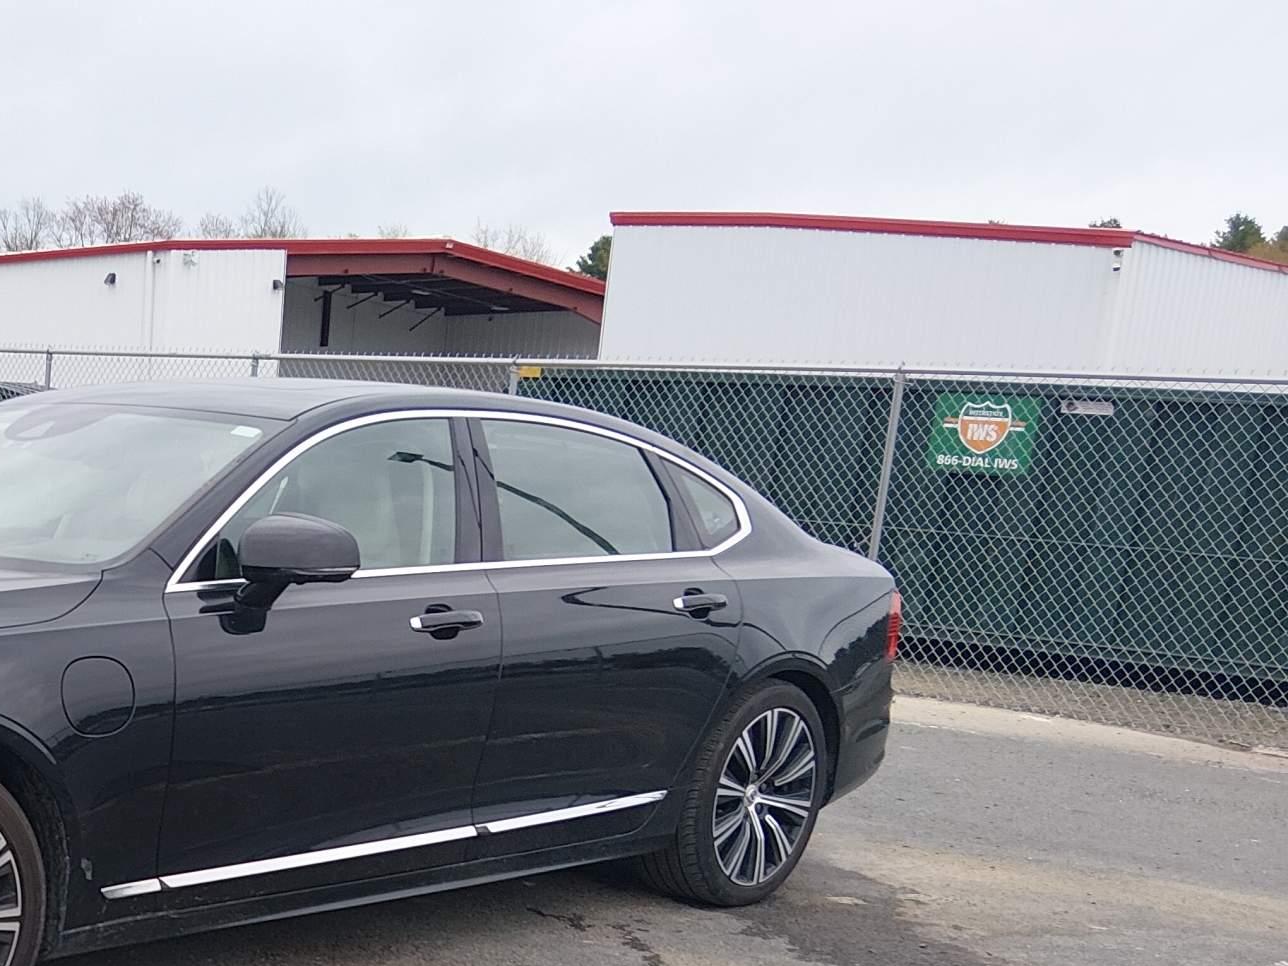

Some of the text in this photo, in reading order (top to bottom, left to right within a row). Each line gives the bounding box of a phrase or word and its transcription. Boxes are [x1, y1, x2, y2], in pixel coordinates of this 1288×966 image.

[967, 424, 998, 442] IWS
[936, 454, 1019, 469] 866-DIAL IWS
